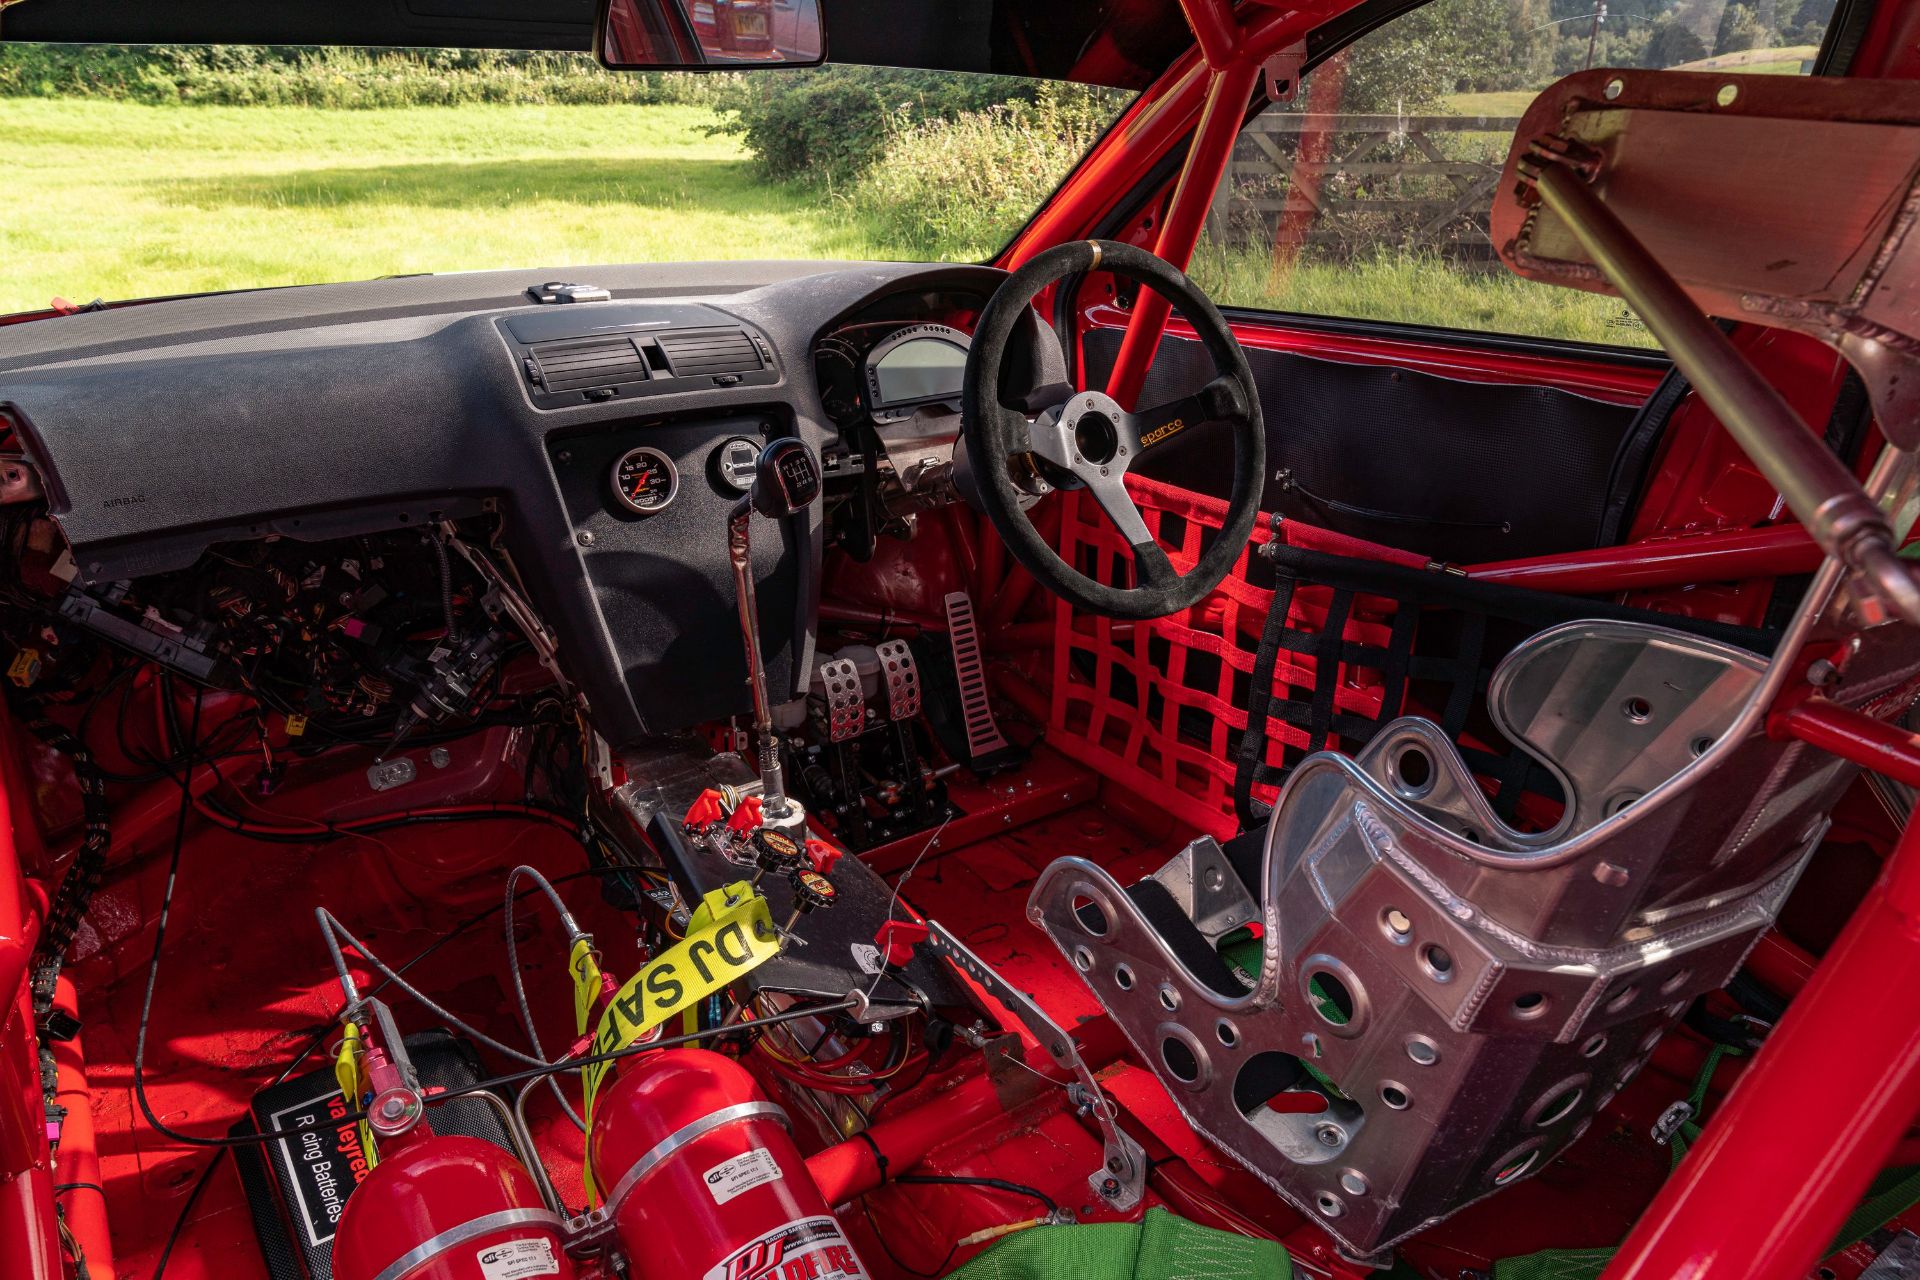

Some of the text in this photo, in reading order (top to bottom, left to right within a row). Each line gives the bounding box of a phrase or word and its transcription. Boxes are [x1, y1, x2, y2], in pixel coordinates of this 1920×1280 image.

[1141, 419, 1183, 445] sparco
[104, 495, 146, 508] AIRBAG
[689, 921, 754, 984] DJ
[296, 1114, 344, 1223] Rcing Batteries
[765, 1231, 788, 1244] RACING
[788, 1223, 808, 1234] SAFETY
